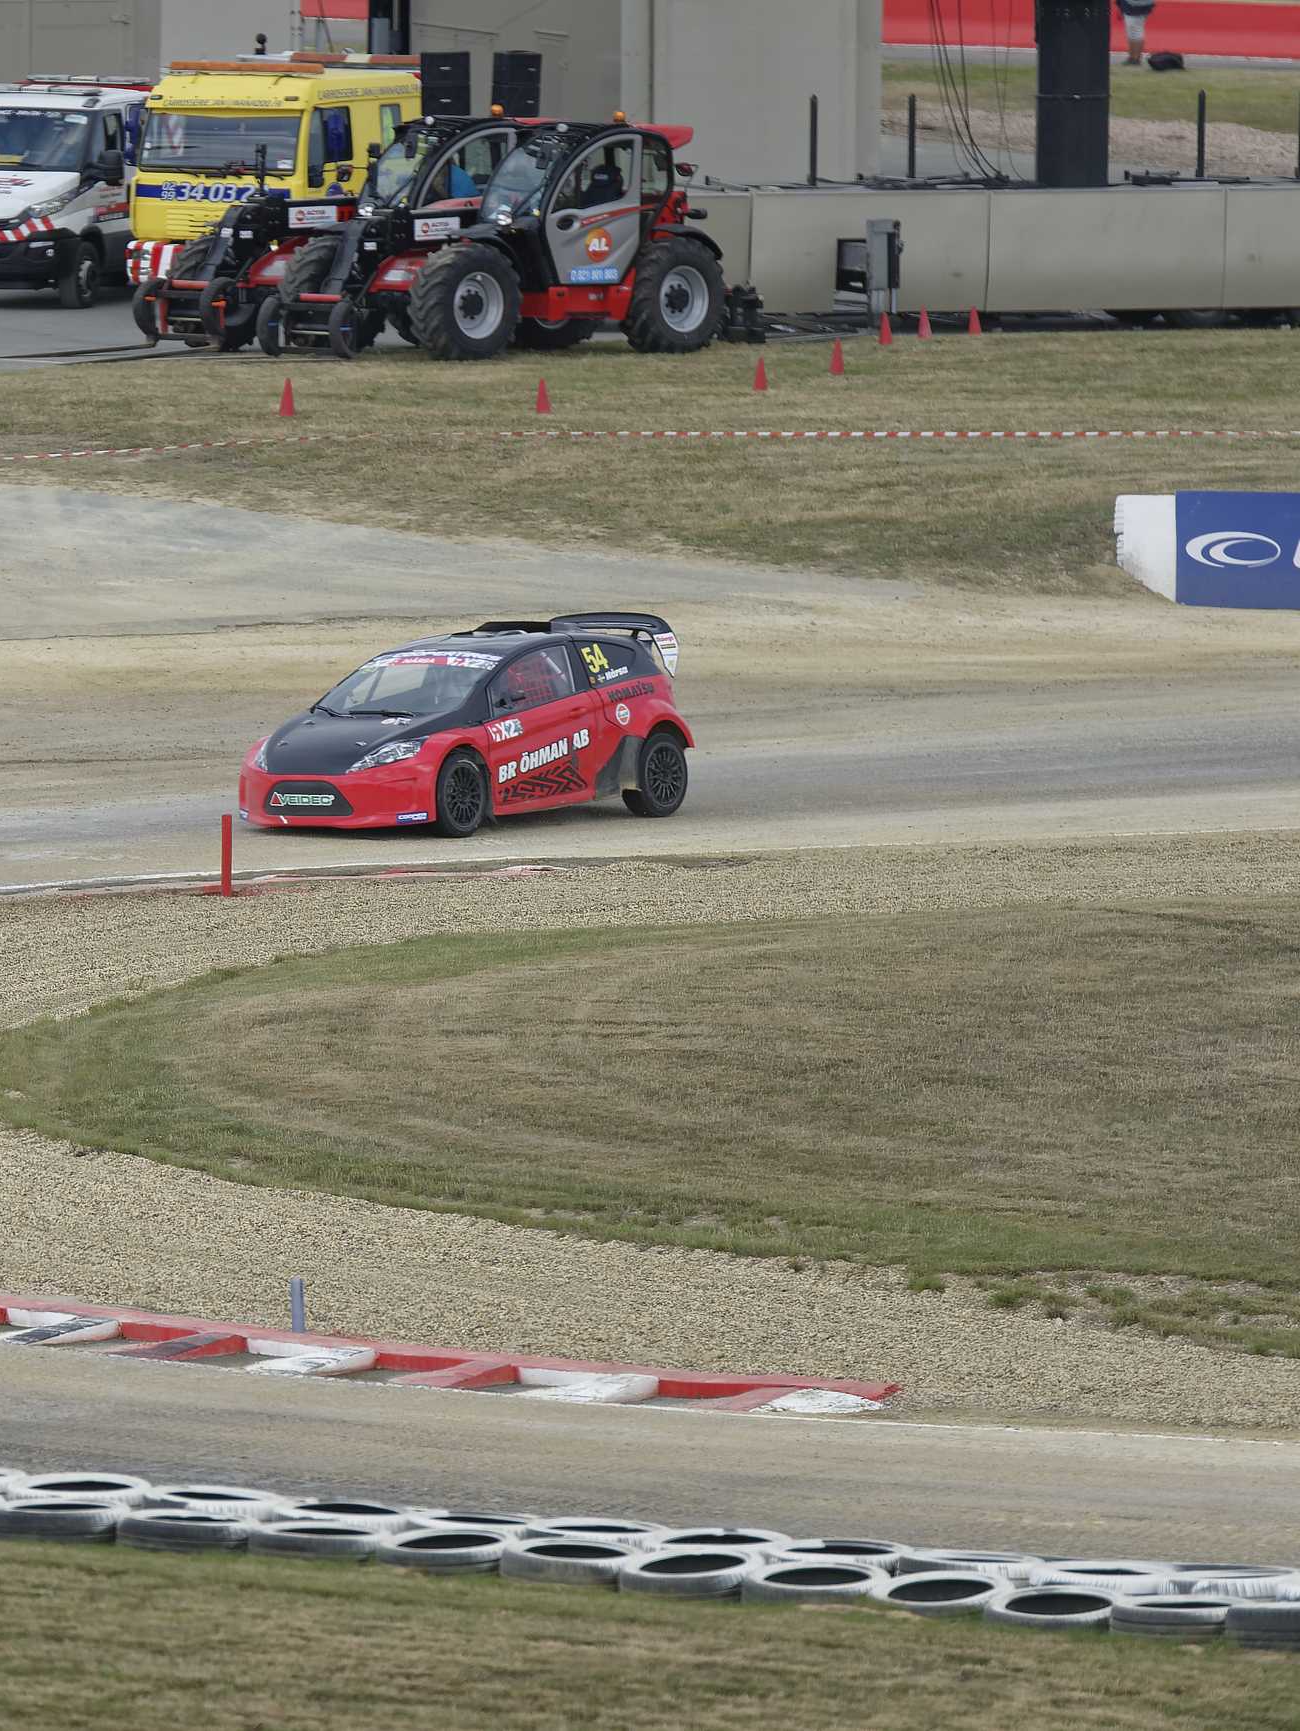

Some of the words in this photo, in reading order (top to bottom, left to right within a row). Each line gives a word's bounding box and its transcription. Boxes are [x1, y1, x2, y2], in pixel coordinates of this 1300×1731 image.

[176, 183, 205, 202] 34
[208, 183, 236, 202] 03
[581, 643, 609, 673] 54
[498, 760, 517, 783] BR
[520, 738, 569, 773] ÖHMAN
[572, 728, 590, 750] AB
[281, 794, 335, 806] VEIDEC
